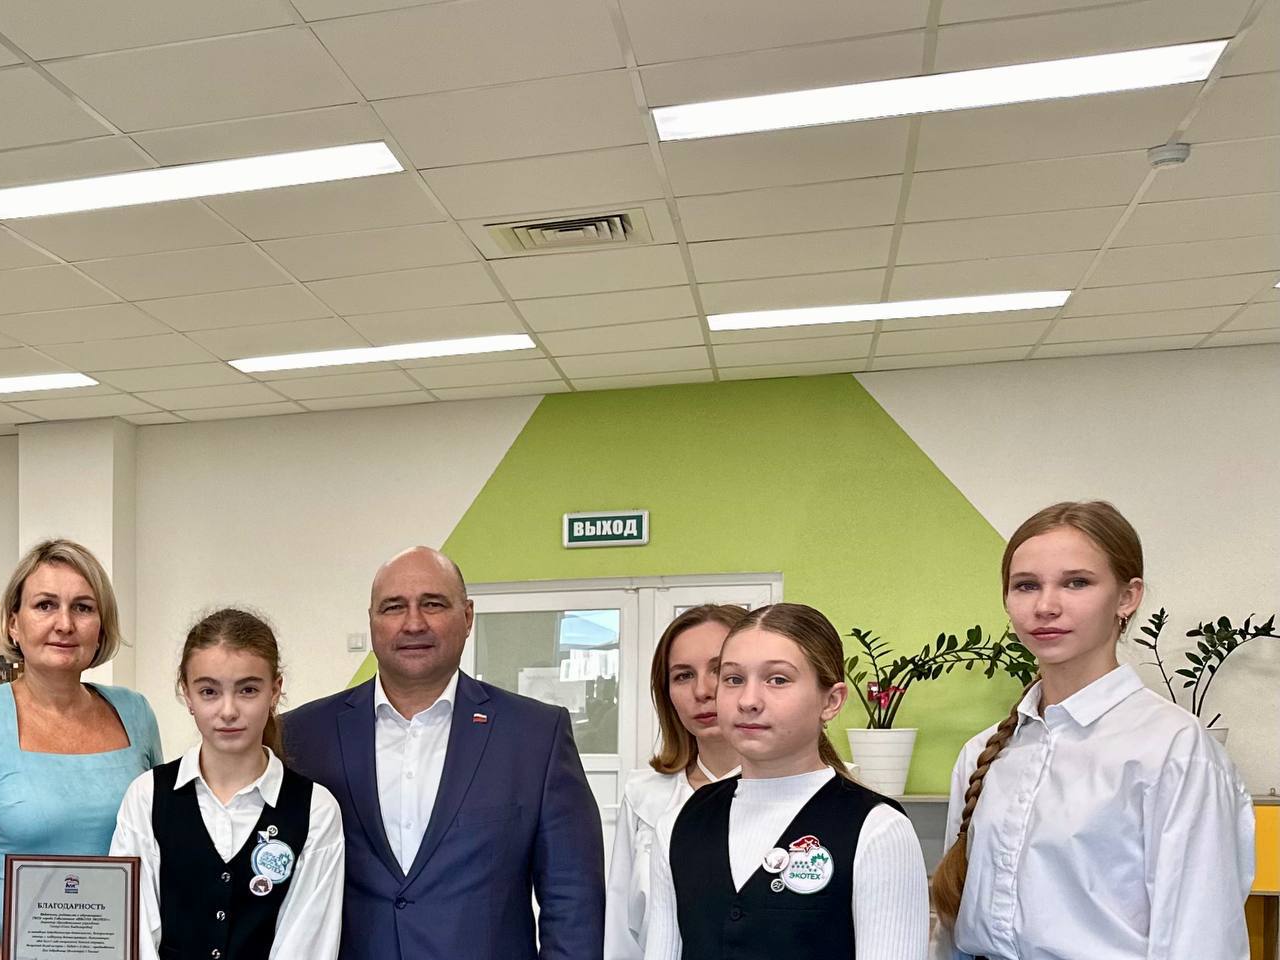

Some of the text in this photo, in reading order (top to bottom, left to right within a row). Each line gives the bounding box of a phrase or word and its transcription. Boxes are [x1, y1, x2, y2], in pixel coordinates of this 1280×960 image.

[573, 519, 638, 537] ВЫХОД
[789, 872, 821, 880] ЭКОТЕХ
[37, 902, 106, 911] БЛАГОДАРНОСТЬ
